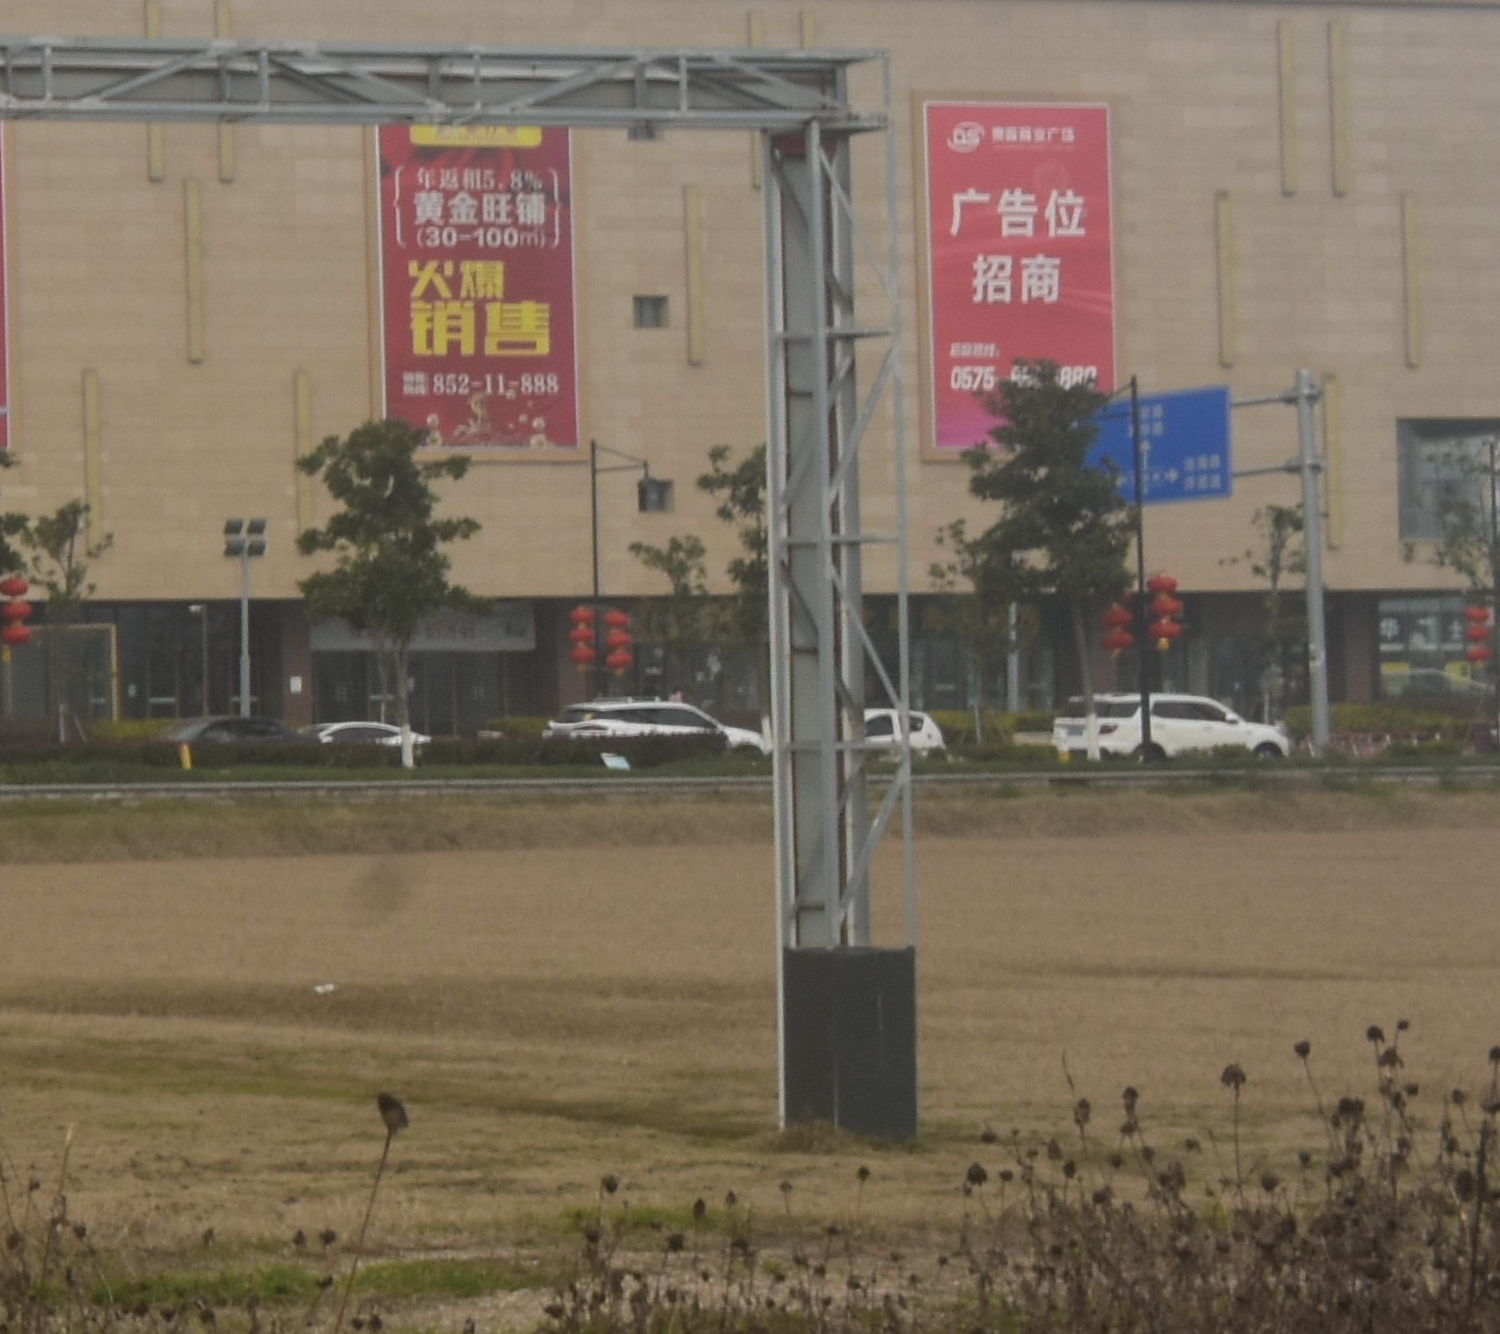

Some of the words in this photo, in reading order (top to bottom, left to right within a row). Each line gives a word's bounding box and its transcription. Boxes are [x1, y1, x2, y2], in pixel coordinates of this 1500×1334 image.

[414, 191, 546, 226] 黄金旺铺
[951, 188, 1085, 237] 广告位
[972, 253, 1061, 304] 招商
[410, 300, 550, 356] 销售
[433, 372, 559, 396] 852-11-888
